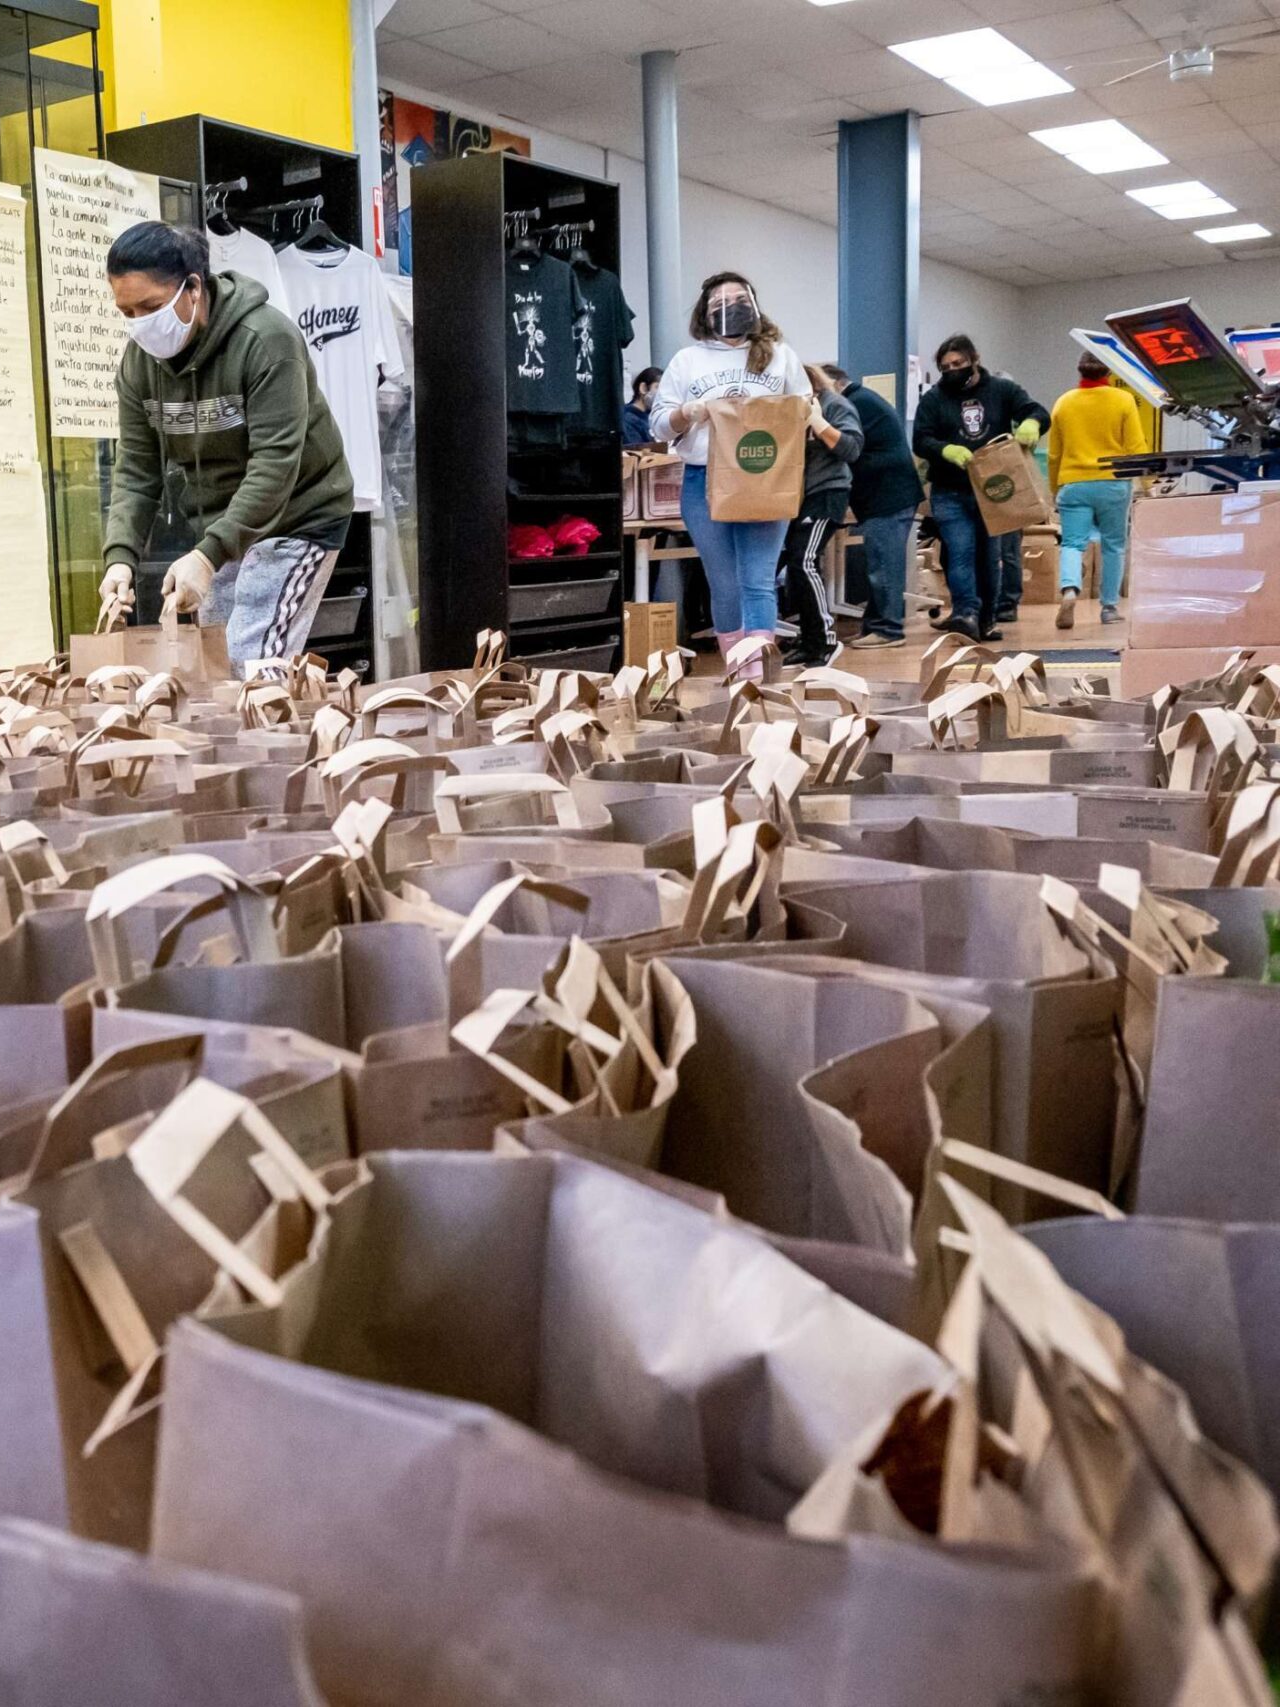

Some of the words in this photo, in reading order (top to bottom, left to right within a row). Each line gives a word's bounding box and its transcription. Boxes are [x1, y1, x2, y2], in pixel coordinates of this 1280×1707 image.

[49, 202, 59, 217] de
[62, 204, 70, 218] la
[52, 219, 63, 239] La
[50, 297, 93, 314] edificador
[97, 302, 109, 319] de
[298, 304, 361, 337] Homey
[53, 321, 72, 340] para
[89, 323, 109, 341] poder
[58, 339, 101, 356] injusticias
[105, 344, 120, 360] que
[93, 378, 104, 391] de
[689, 374, 716, 398] SAN
[715, 368, 784, 392] FRANCISCO
